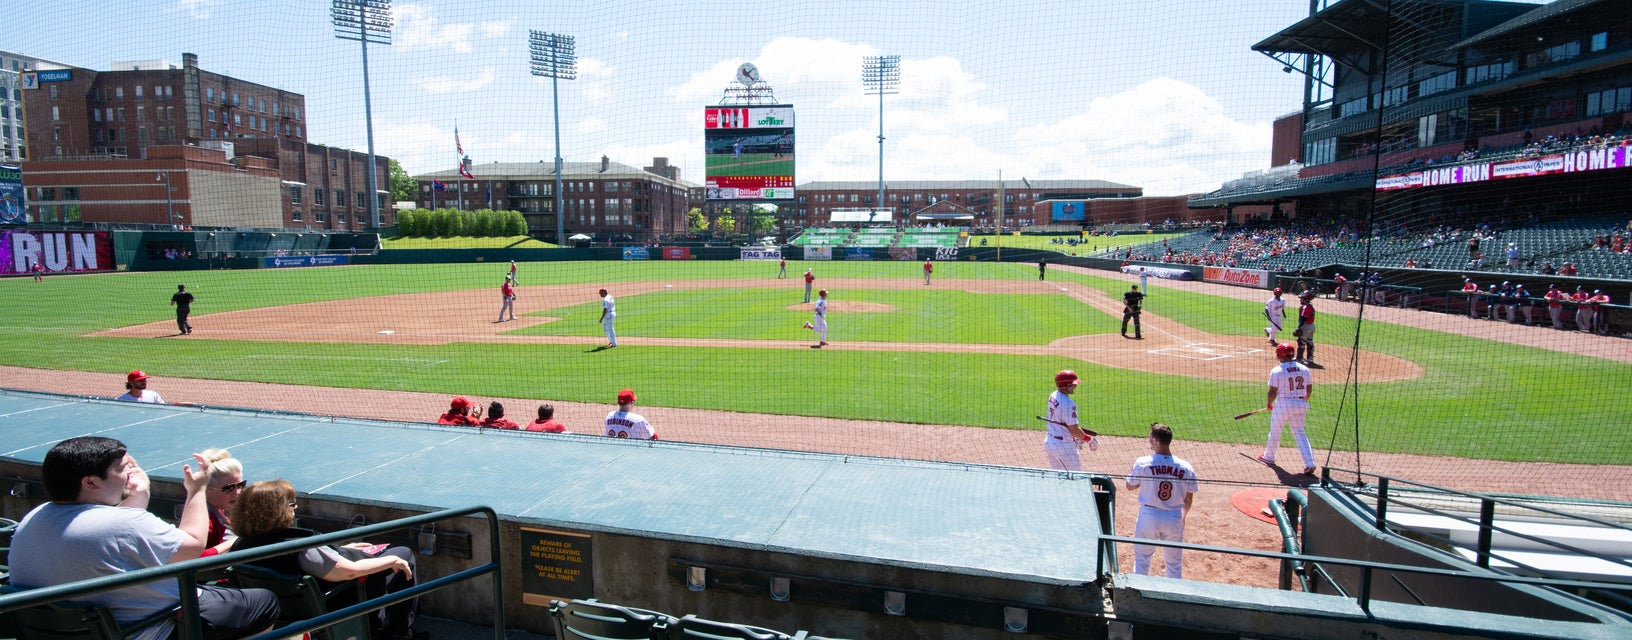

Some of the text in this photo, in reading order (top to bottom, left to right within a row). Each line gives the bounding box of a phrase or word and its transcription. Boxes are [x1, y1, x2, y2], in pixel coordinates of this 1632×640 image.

[758, 115, 784, 126] LOTTERY
[1495, 160, 1560, 173] INTERNATIONAL PAPER
[1564, 147, 1617, 172] HOME
[1423, 163, 1490, 187] HOME RUN
[12, 232, 98, 272] RUN
[742, 250, 780, 259] TAG TAG
[1224, 268, 1260, 285] AutoZone
[1288, 376, 1305, 391] 12
[607, 418, 633, 428] ROBINSON
[1149, 465, 1186, 479] THOMAS
[1158, 481, 1173, 501] 8
[556, 548, 580, 556] LEAVING
